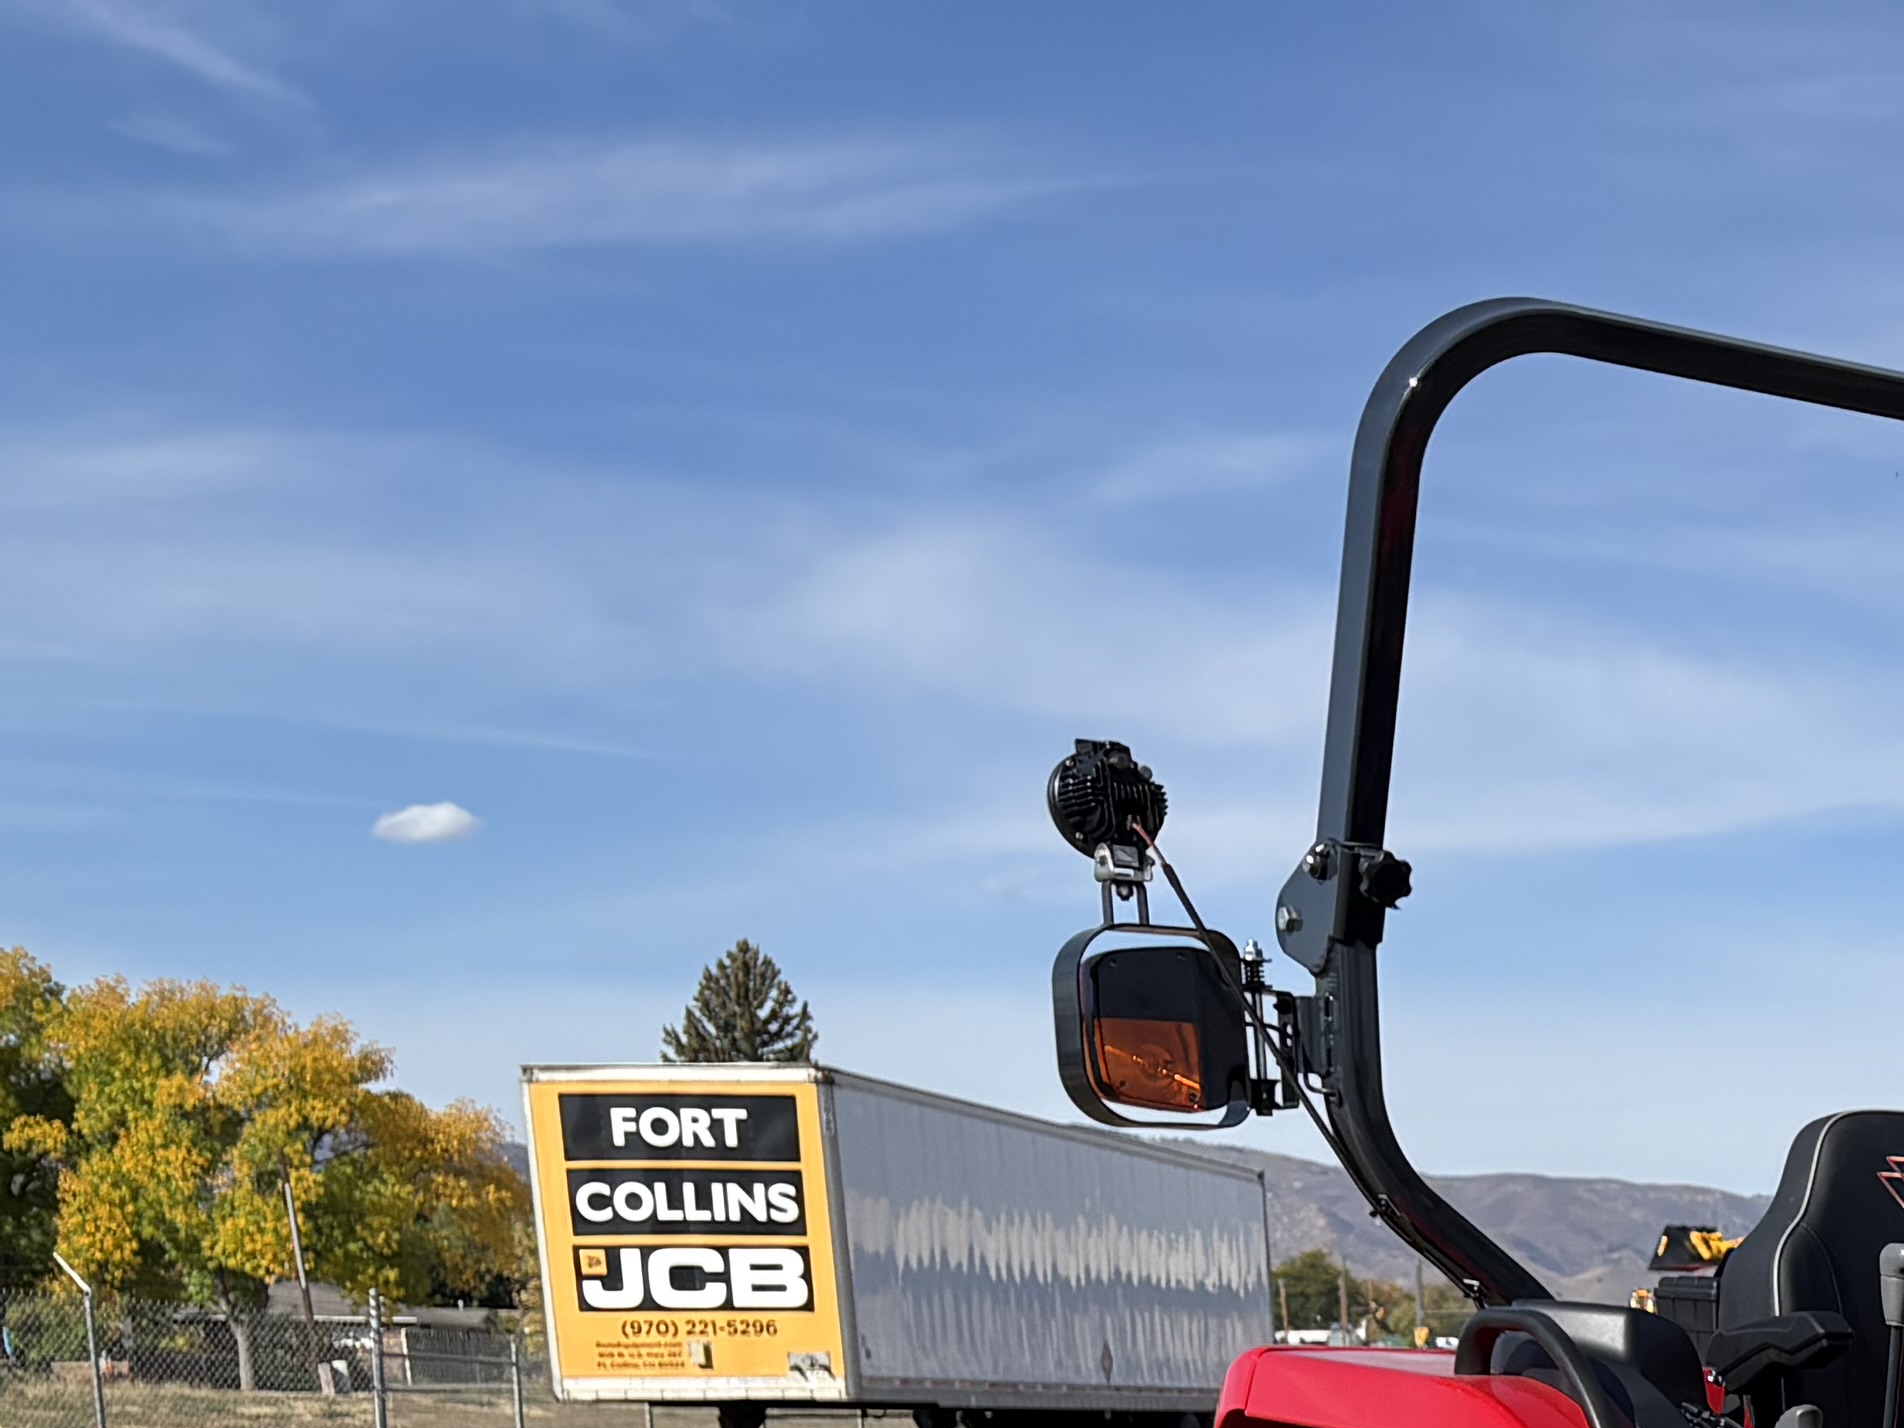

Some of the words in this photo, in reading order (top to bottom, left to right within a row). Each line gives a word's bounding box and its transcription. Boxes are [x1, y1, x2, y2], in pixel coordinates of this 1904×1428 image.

[609, 1106, 748, 1149] FORT
[574, 1181, 801, 1224] COLLINS
[582, 1247, 809, 1310] JCB
[621, 1319, 679, 1340] (970)
[684, 1319, 778, 1338] 221-5296
